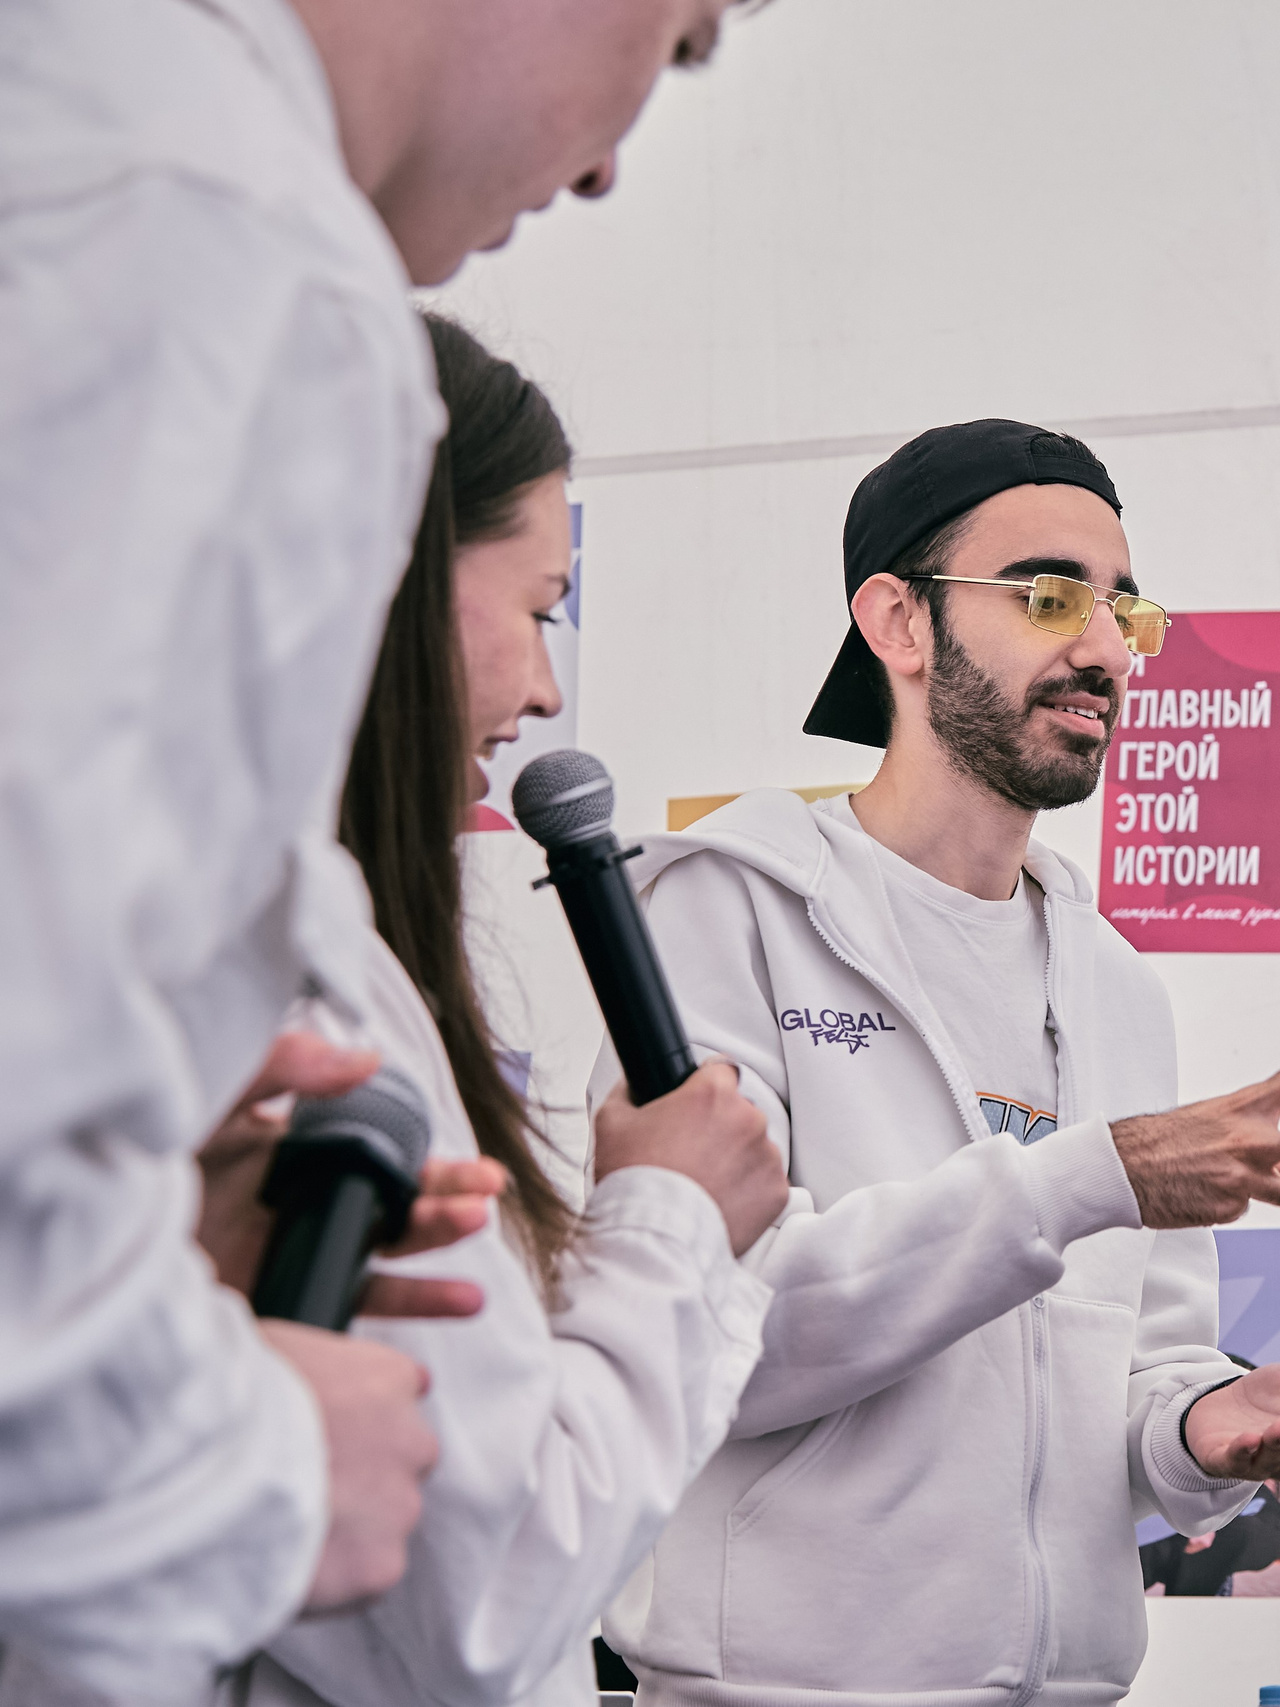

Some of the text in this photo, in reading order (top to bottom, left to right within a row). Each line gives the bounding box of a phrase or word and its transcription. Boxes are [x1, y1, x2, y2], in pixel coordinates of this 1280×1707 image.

[1121, 681, 1272, 729] ГЛАВНЫЙ
[1118, 733, 1220, 781] ГЕРОЙ
[1115, 785, 1199, 833] ЭТОЙ
[1113, 845, 1260, 886] ИСТОРИИ
[1110, 906, 1179, 926] история
[1181, 902, 1198, 921] в
[780, 1008, 897, 1033] GLOBAL
